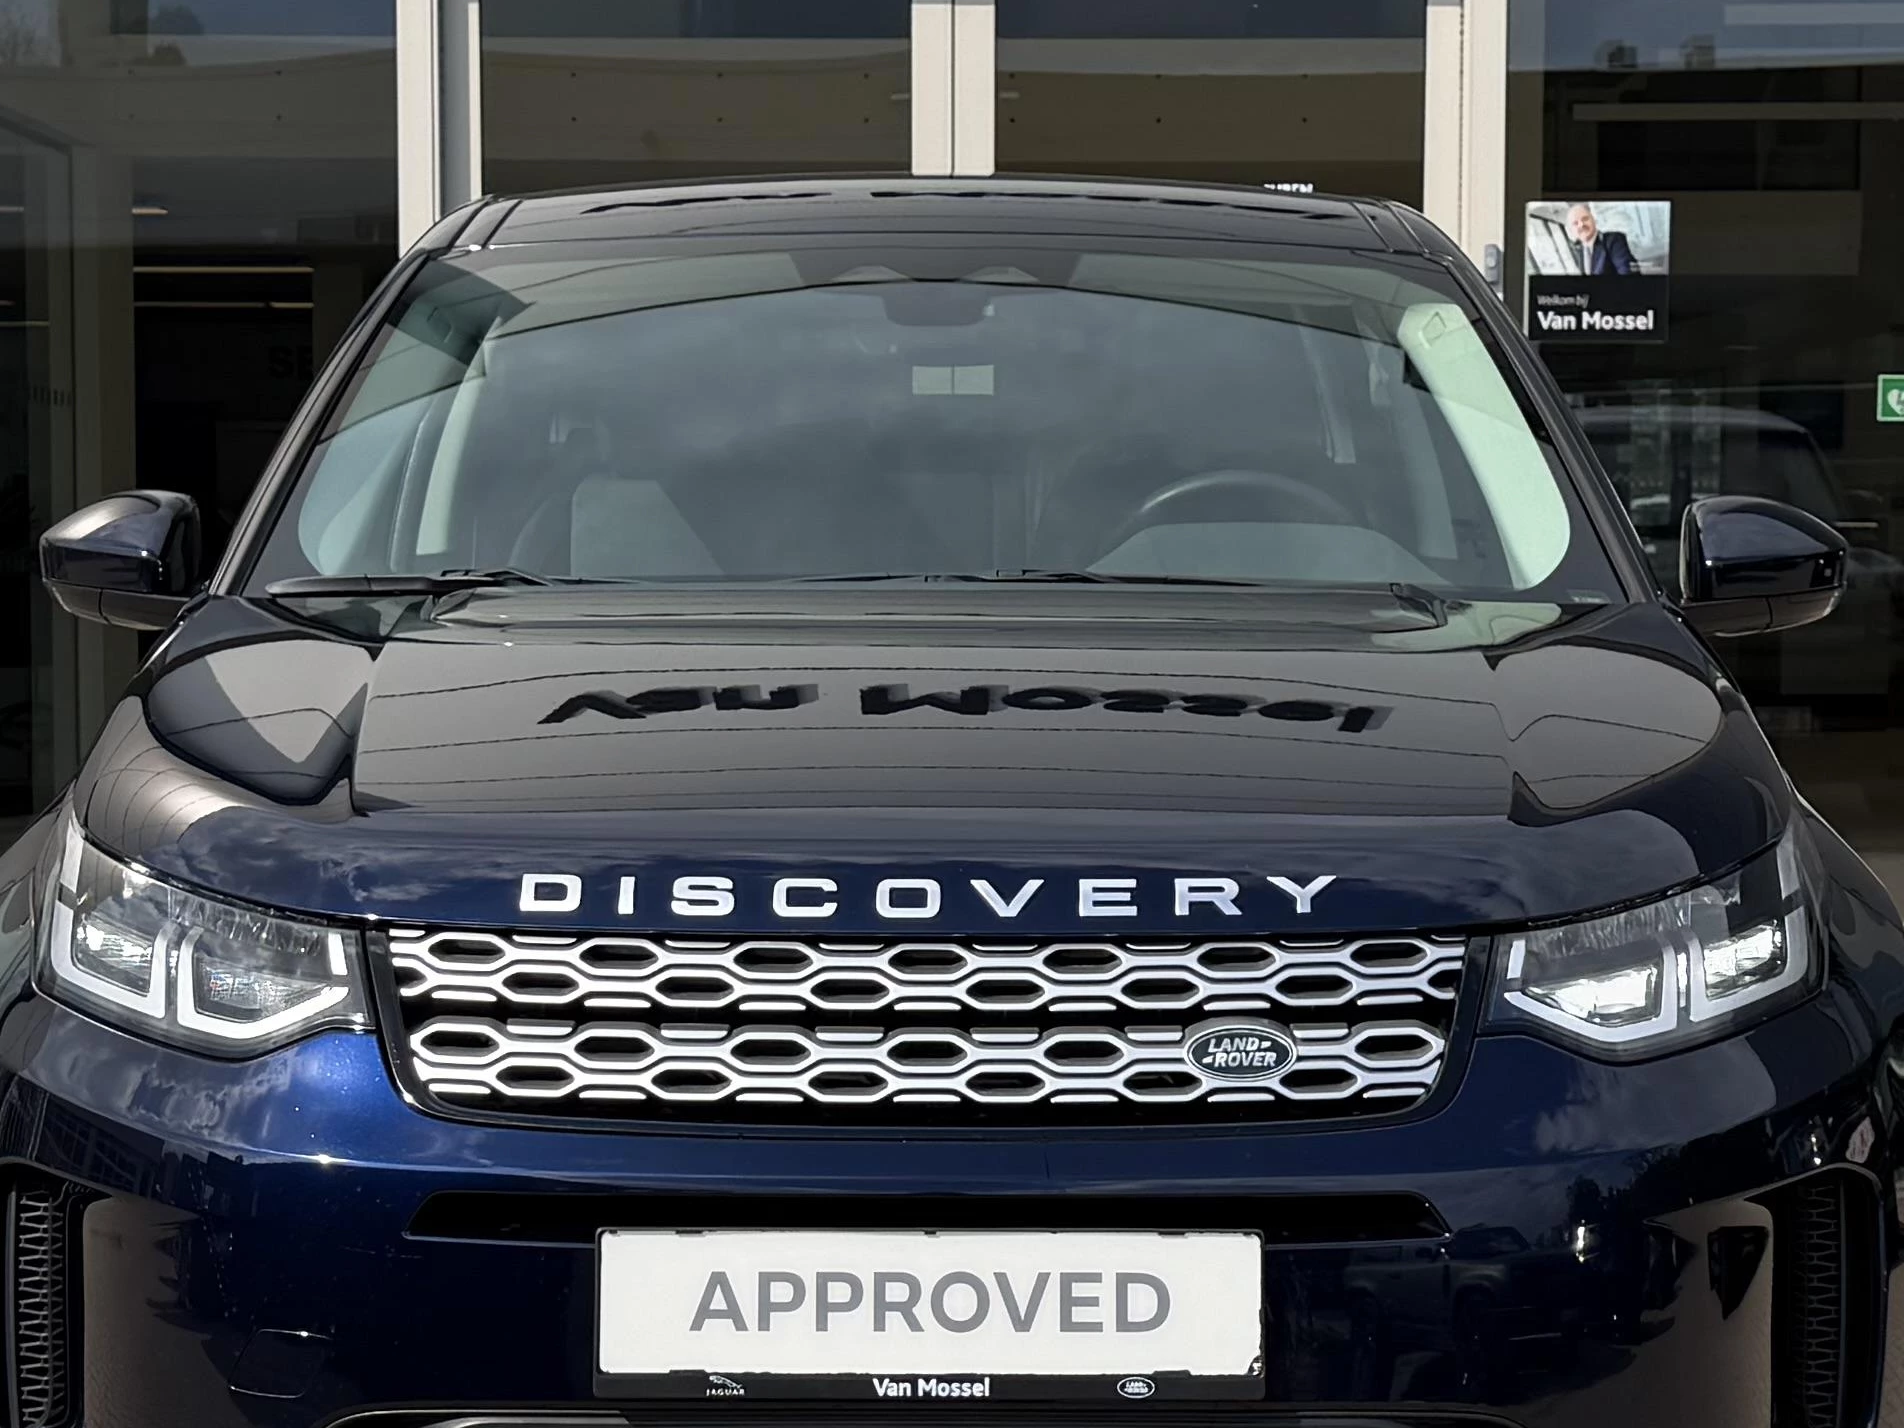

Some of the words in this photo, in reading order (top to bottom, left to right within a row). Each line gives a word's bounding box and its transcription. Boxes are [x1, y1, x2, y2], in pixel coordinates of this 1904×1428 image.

[1537, 311, 1576, 330] Van
[1582, 310, 1653, 330] Mossel
[519, 873, 1337, 918] DISCOVERY
[1208, 1037, 1259, 1052] LAND
[1214, 1052, 1277, 1067] ROVER
[689, 1270, 1172, 1334] APPROVED
[706, 1388, 745, 1396] JAGUAR
[872, 1378, 911, 1397] Van
[918, 1377, 990, 1397] Mossel
